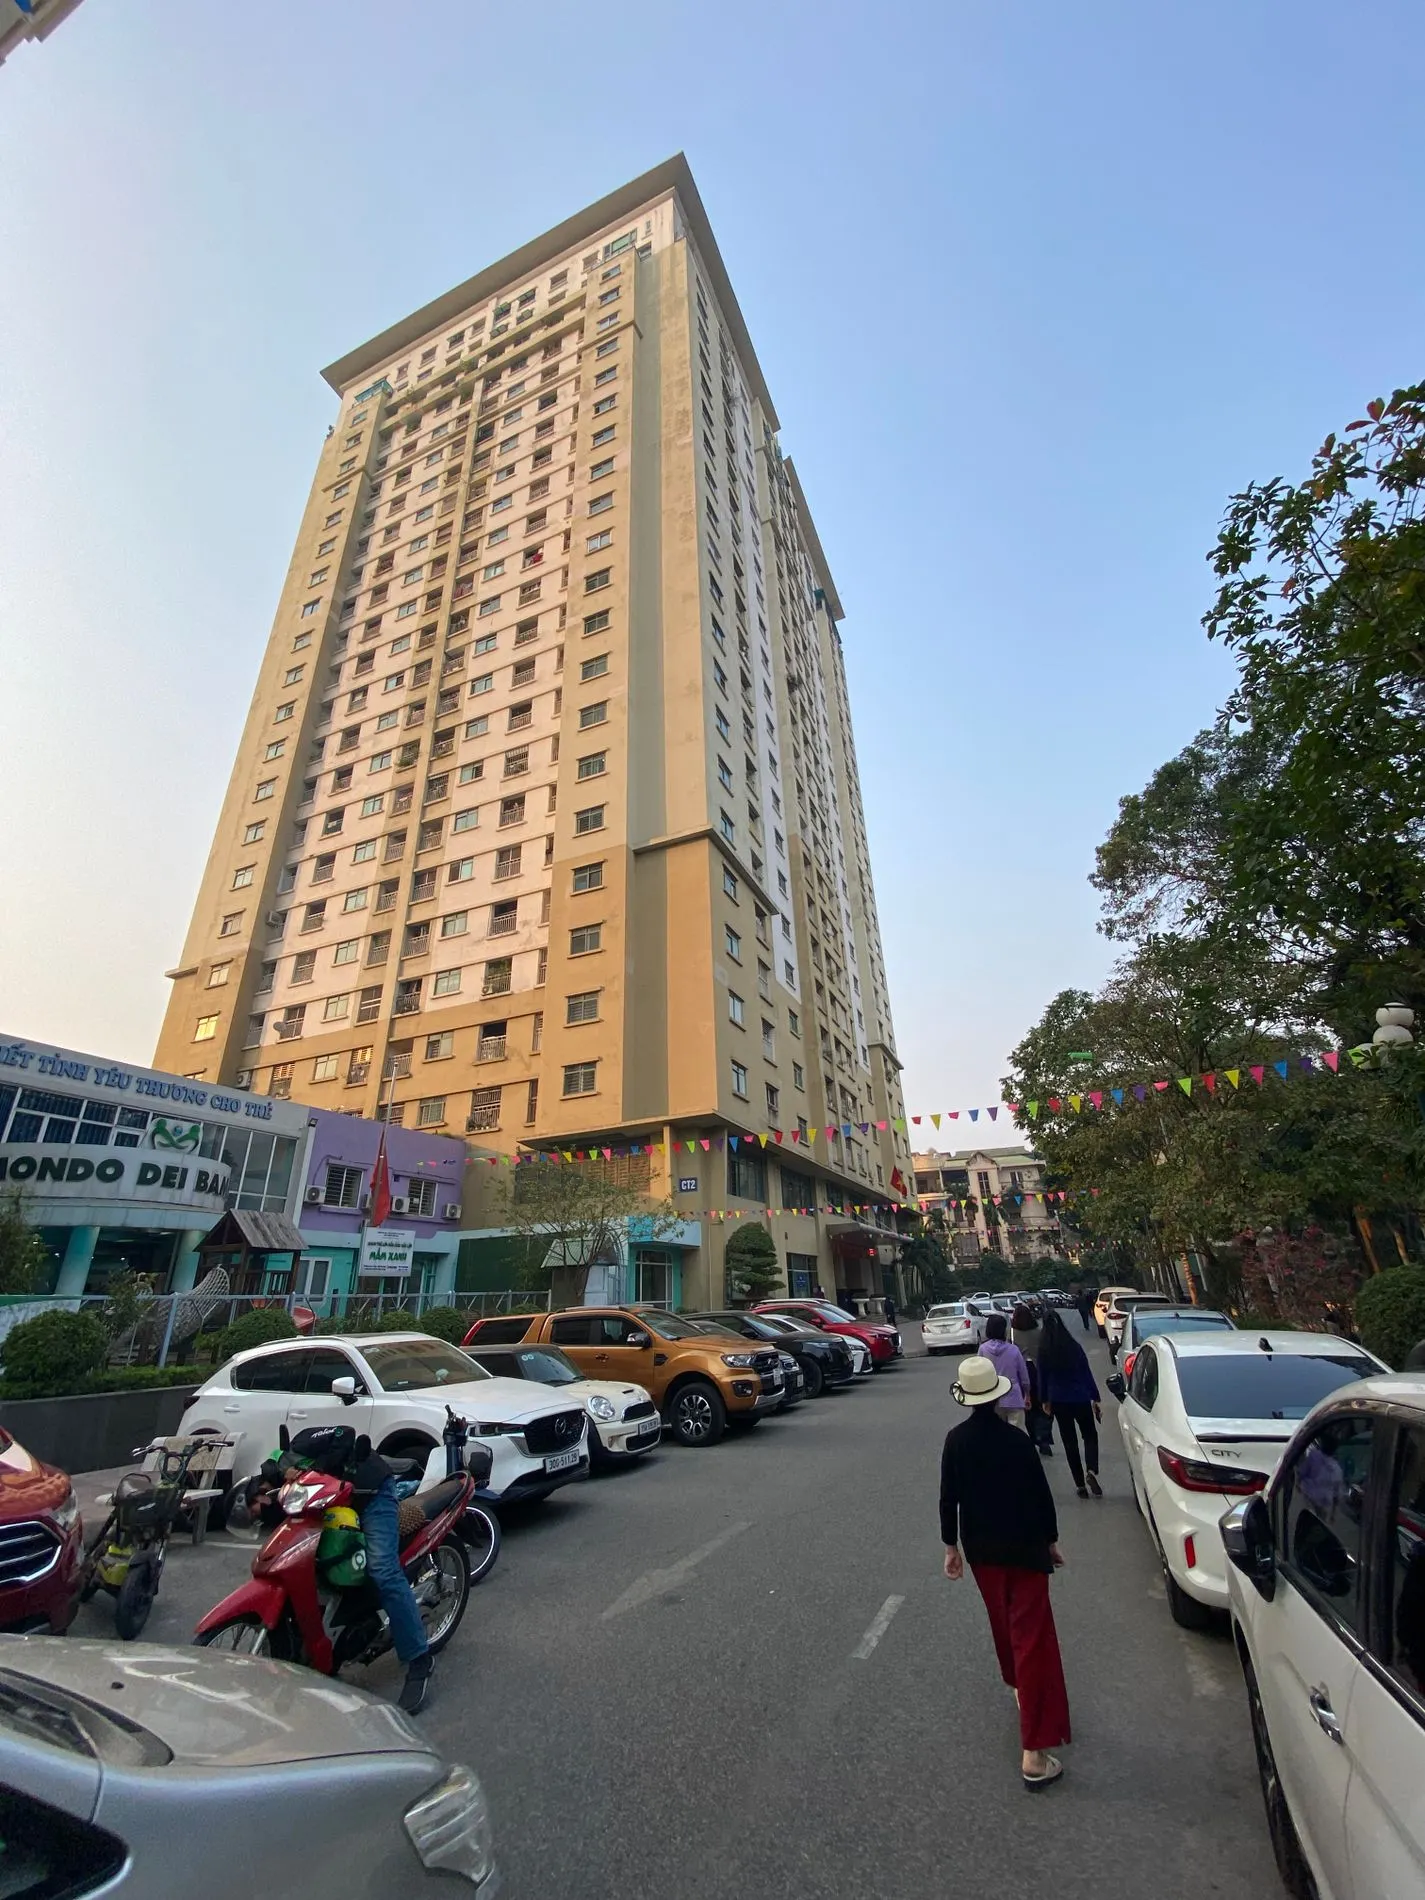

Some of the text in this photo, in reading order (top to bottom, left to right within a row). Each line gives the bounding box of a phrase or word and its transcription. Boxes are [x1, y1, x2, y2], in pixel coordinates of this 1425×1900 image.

[94, 1066, 133, 1089] YÊU
[210, 1095, 241, 1113] CHO
[136, 1162, 188, 1189] DEI
[681, 1179, 696, 1190] CT2
[1211, 1449, 1242, 1458] CITY
